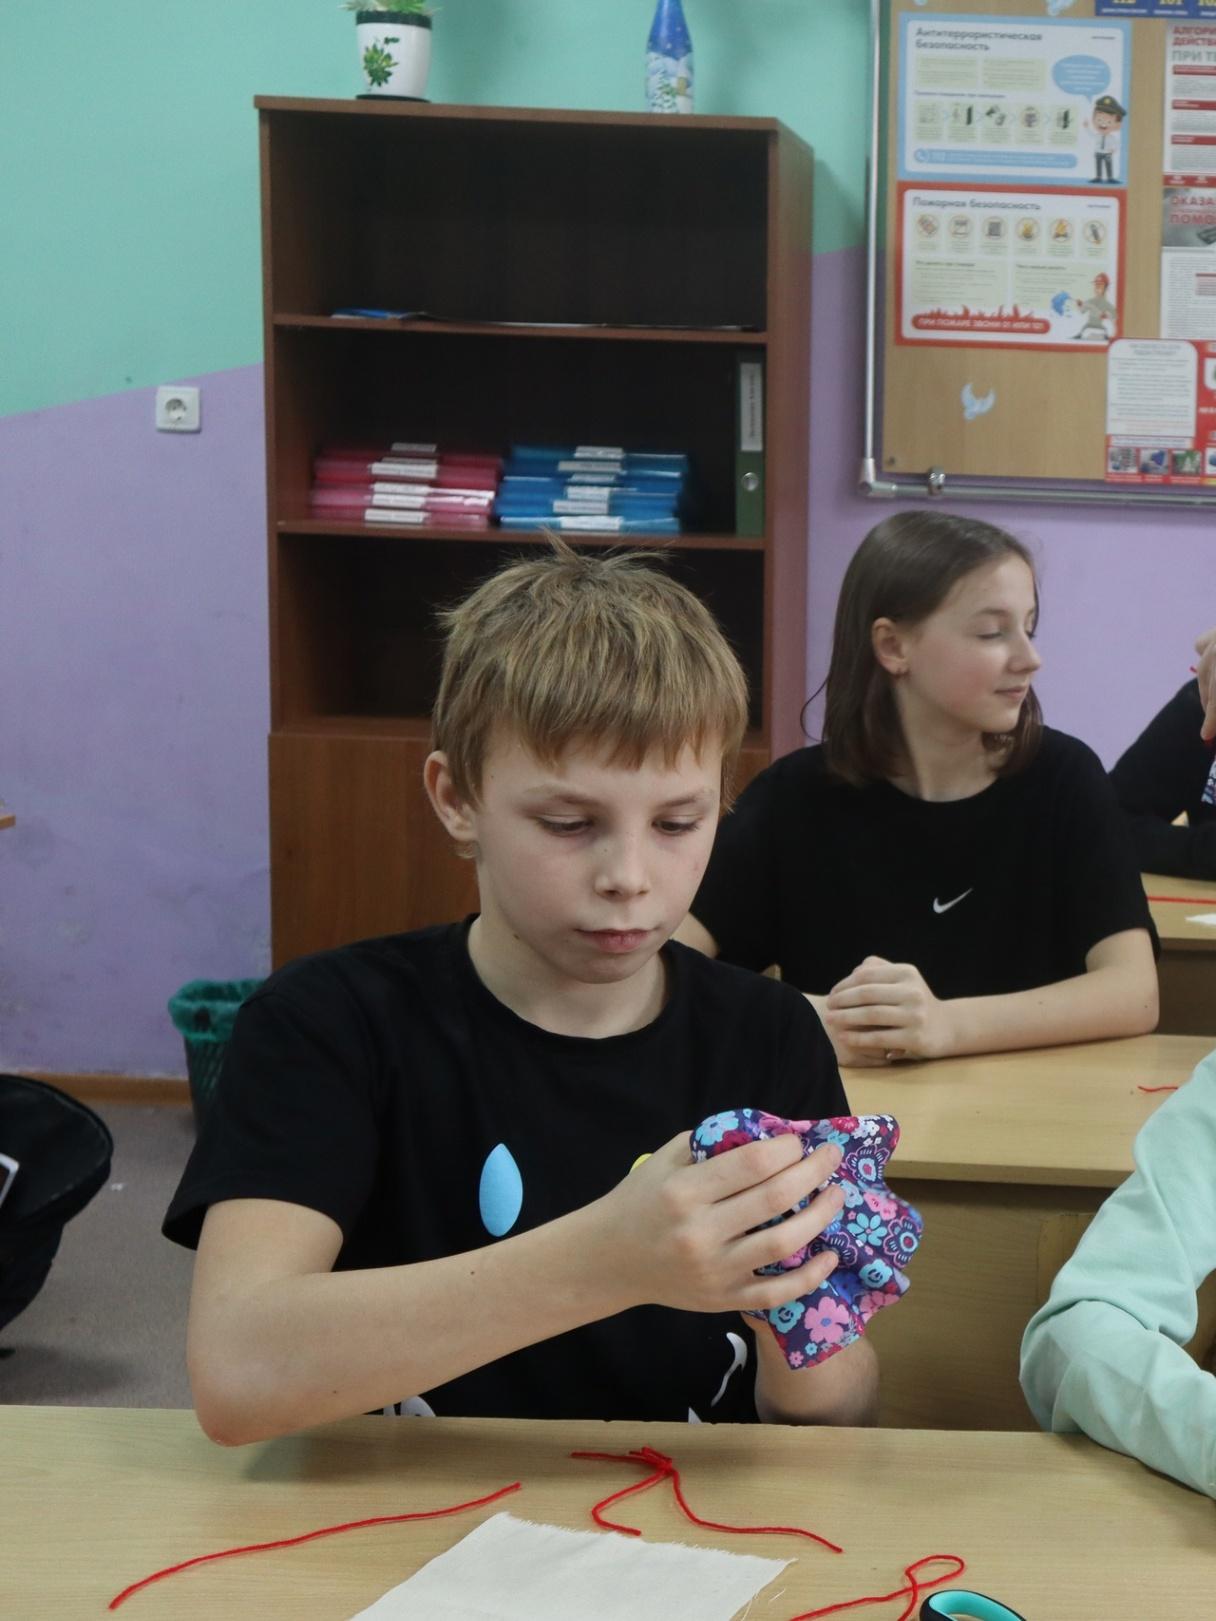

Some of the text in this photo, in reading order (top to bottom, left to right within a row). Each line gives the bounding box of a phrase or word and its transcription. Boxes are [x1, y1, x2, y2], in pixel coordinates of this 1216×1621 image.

[916, 27, 1042, 41] Антитеррористическая
[916, 39, 990, 51] безопасность
[1172, 50, 1202, 62] ПРИ
[912, 196, 1042, 210] Пожарная безопасность
